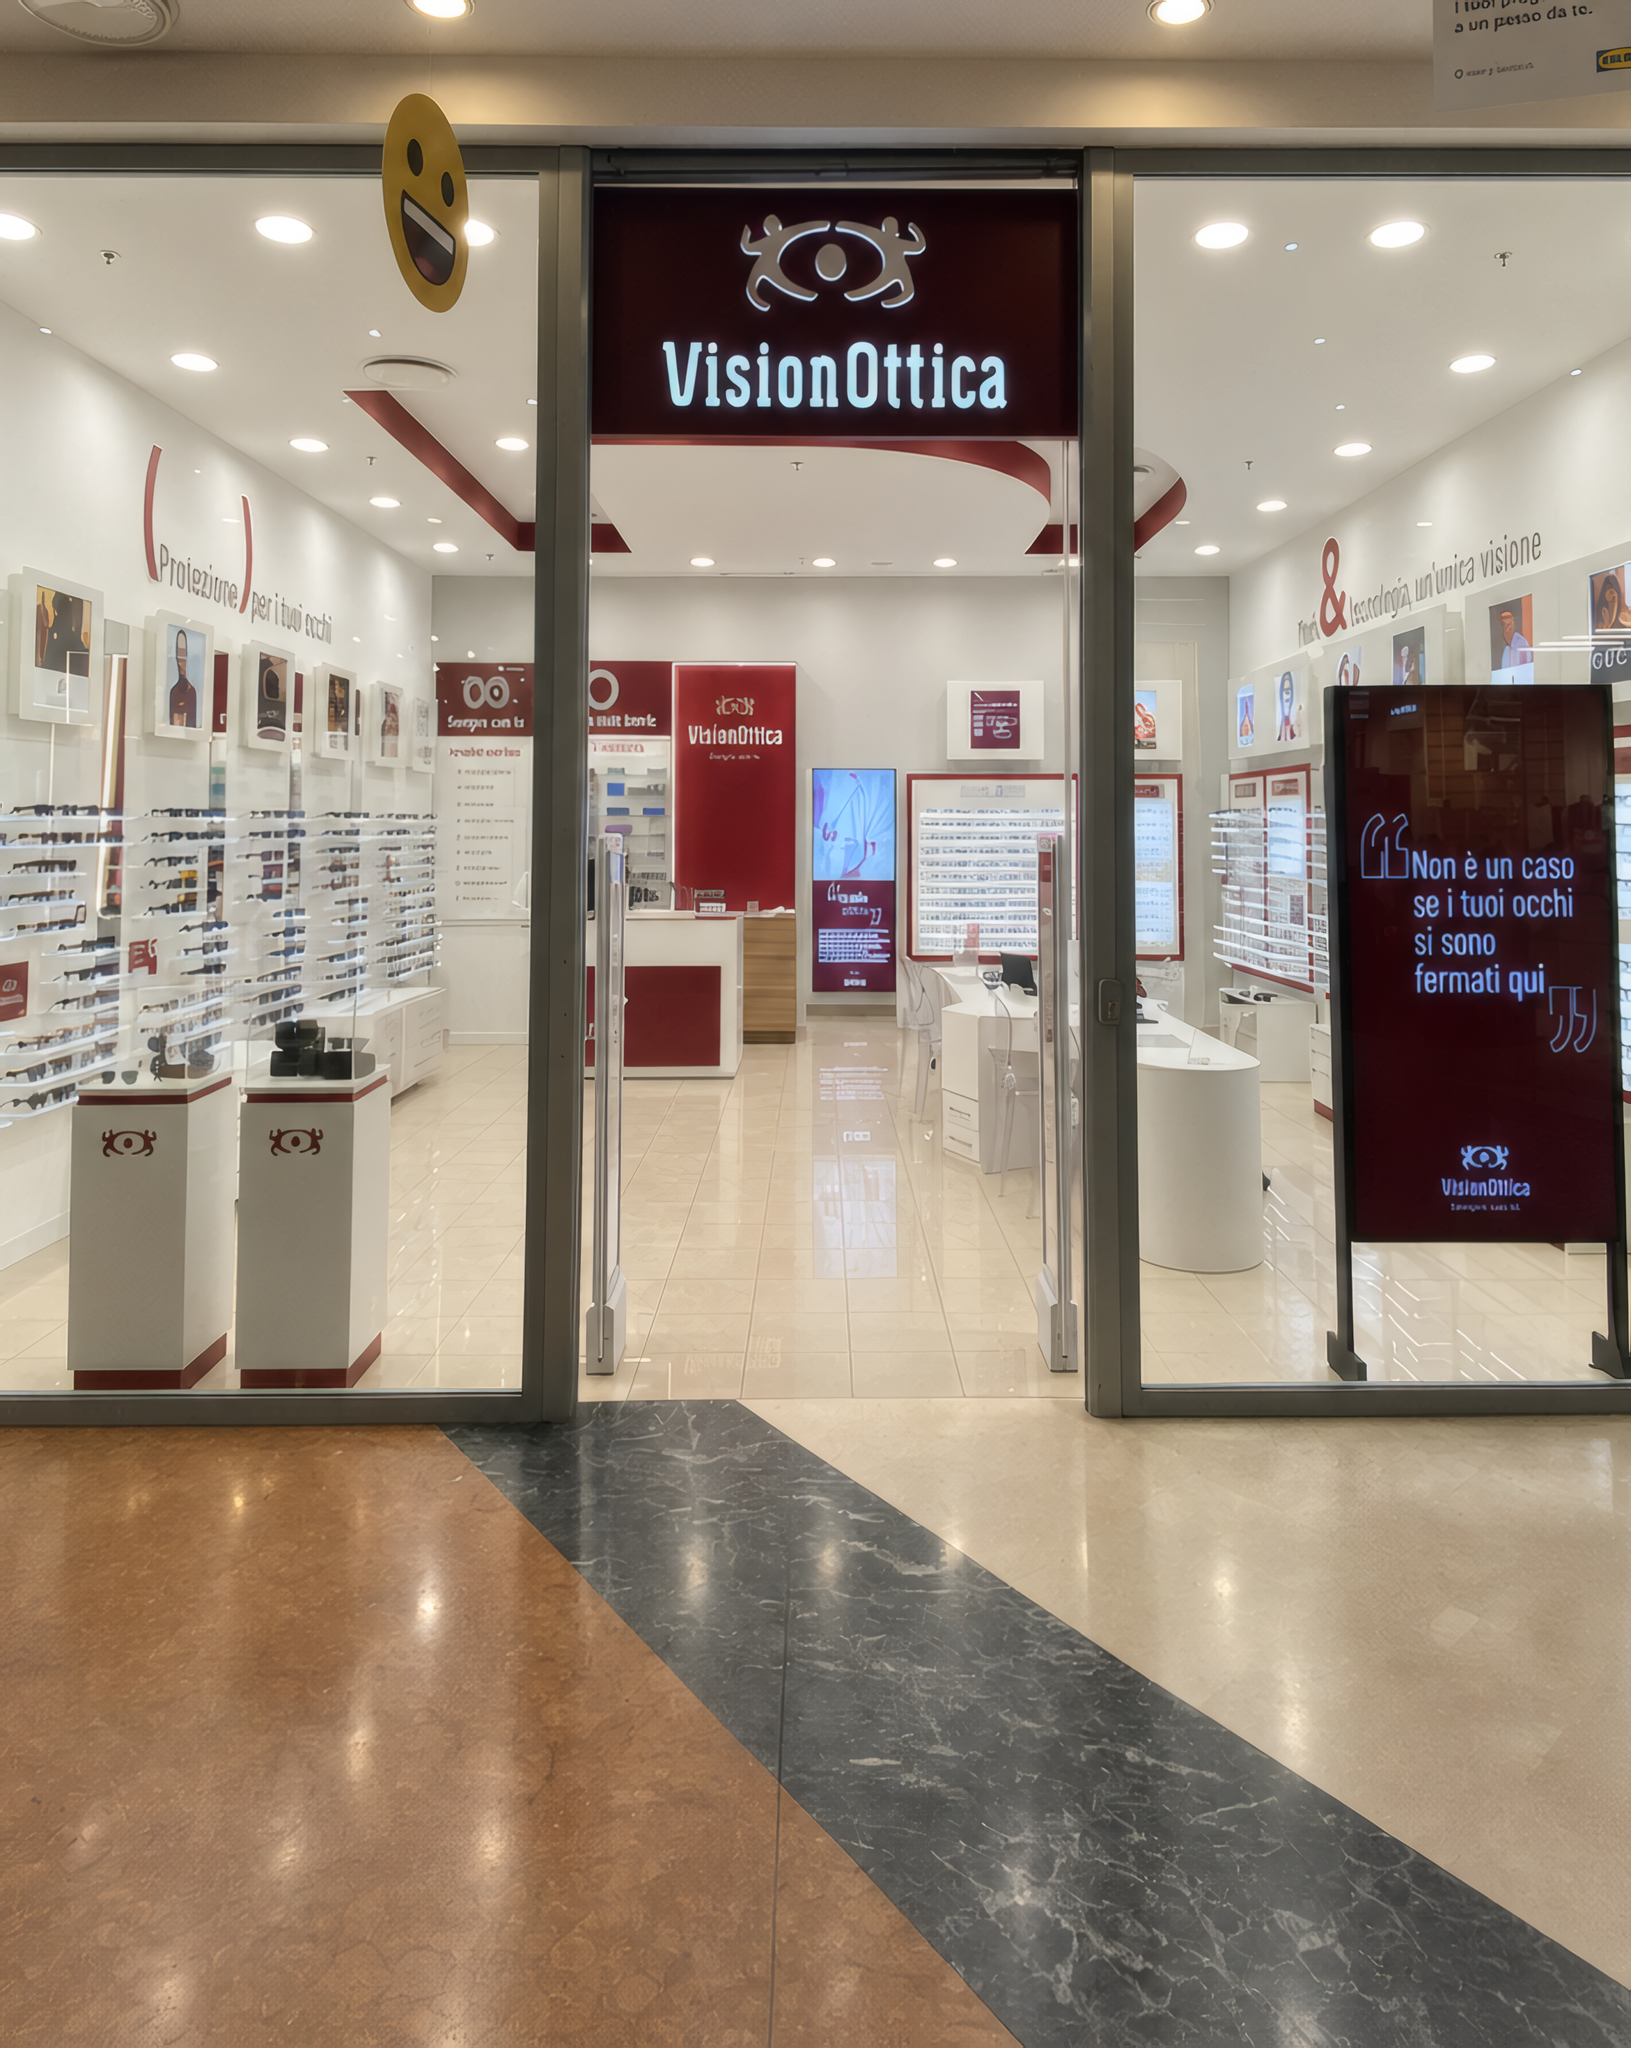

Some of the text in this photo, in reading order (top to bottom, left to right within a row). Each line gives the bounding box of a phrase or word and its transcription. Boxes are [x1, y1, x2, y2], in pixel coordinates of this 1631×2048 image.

[1469, 19, 1489, 31] un
[662, 341, 1008, 409] VisionOttica
[1480, 532, 1542, 579] visione
[1412, 850, 1575, 880] Non è un caso
[1413, 887, 1573, 918] se i tuoi occhi
[1414, 926, 1496, 956] si sono
[1414, 963, 1545, 1003] fermati qui
